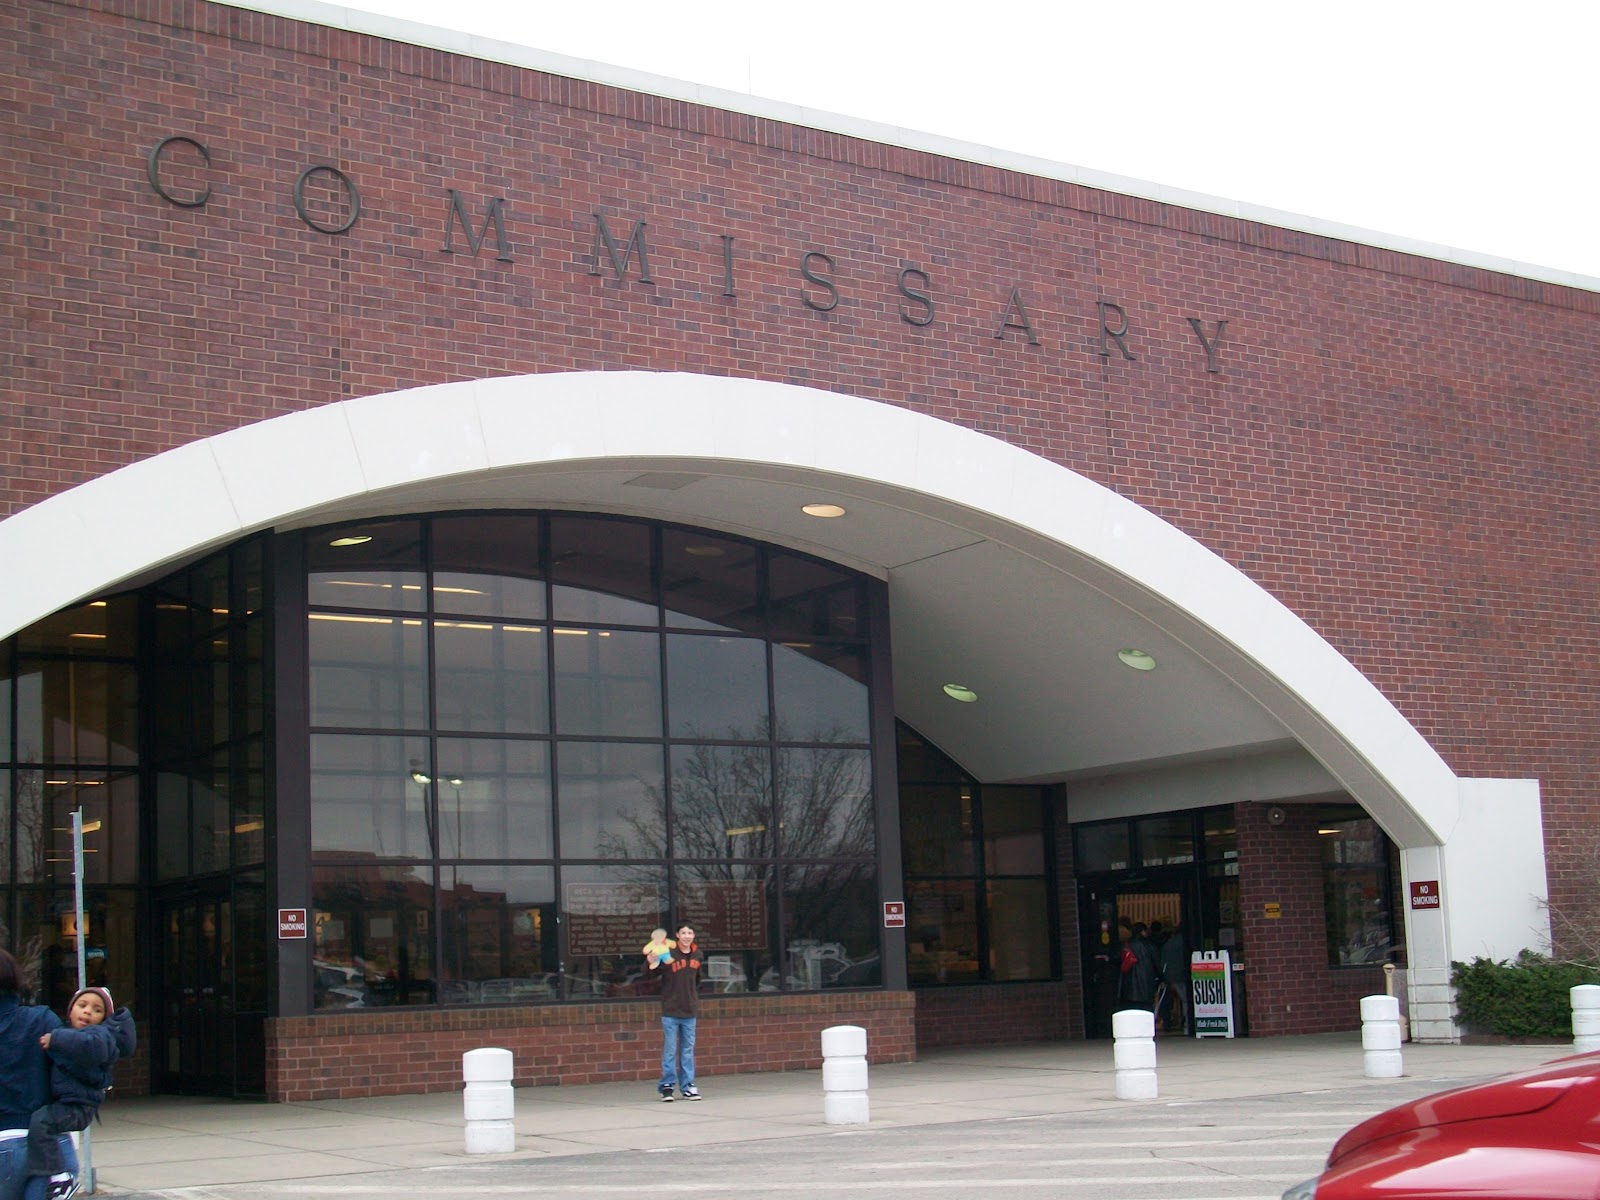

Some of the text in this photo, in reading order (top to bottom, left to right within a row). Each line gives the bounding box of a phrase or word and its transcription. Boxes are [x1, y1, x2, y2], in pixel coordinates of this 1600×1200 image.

[147, 135, 1229, 373] COMMISSARY
[1419, 885, 1429, 894] NO
[1412, 895, 1438, 906] SMOKING
[287, 914, 297, 922] NO
[280, 923, 305, 931] SMOKING
[1194, 980, 1227, 1005] SUSHI
